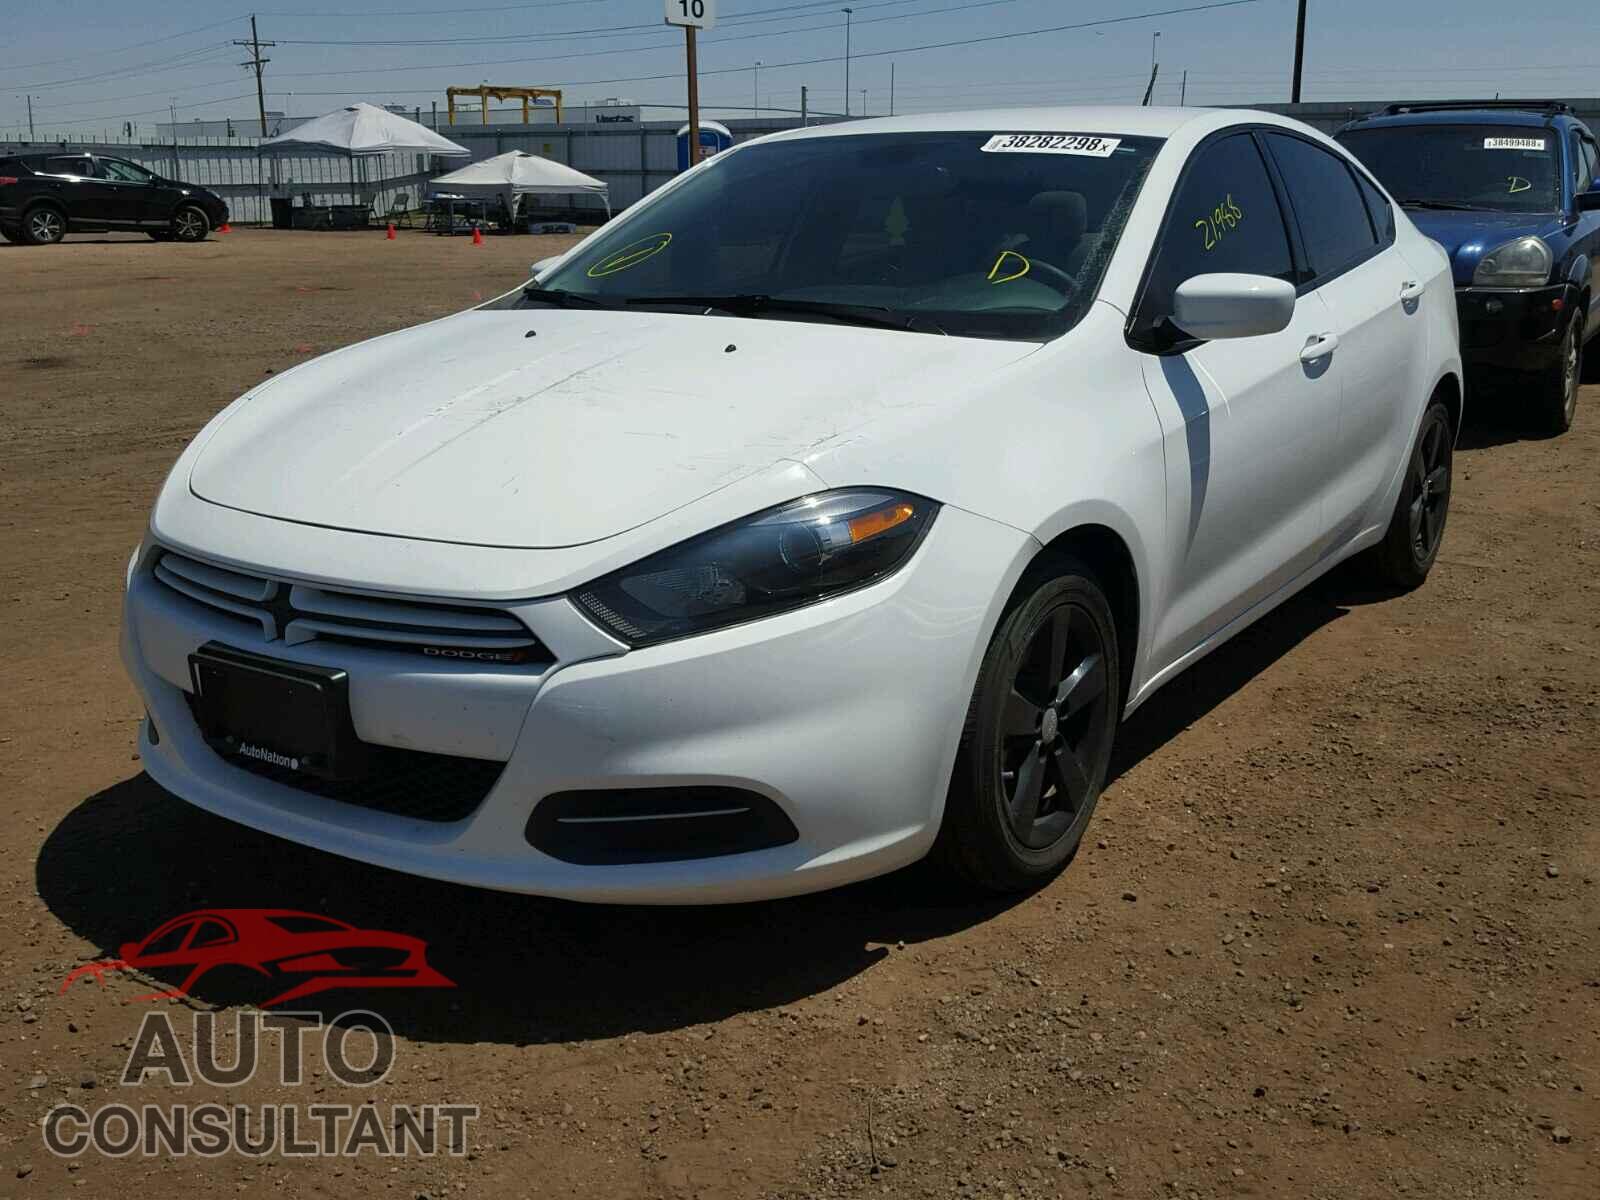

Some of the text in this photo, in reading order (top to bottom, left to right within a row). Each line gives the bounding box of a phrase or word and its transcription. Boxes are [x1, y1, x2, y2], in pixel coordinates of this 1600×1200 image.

[679, 0, 704, 18] 10
[1507, 176, 1531, 193] D
[987, 250, 1030, 285] D
[423, 647, 513, 661] DODGE
[240, 742, 290, 768] AutoNation
